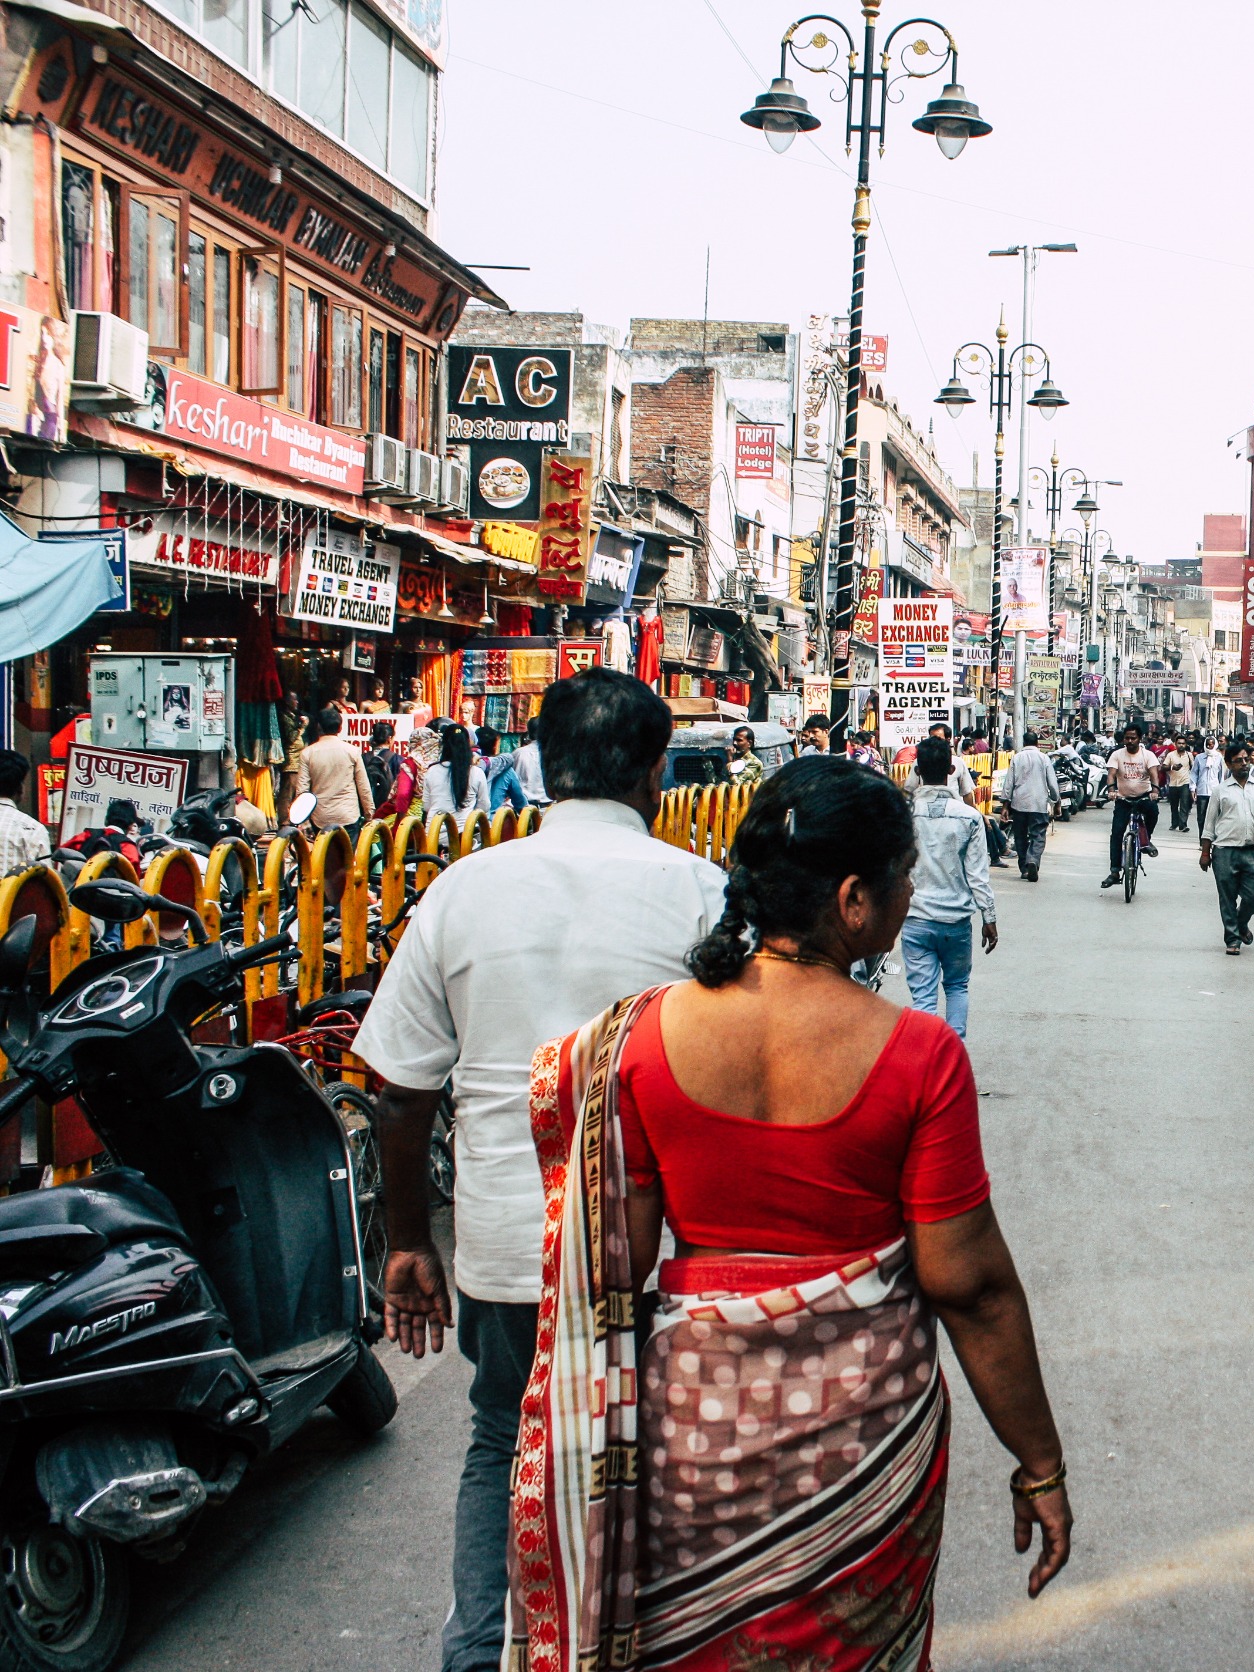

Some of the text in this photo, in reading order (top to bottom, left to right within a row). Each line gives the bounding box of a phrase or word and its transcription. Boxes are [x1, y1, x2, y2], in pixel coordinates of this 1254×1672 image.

[90, 78, 201, 175] KESHARI
[458, 355, 558, 408] A C
[447, 413, 567, 442] Restaurant
[738, 428, 773, 443] TRIPTI
[271, 418, 323, 453] Ruchikar
[324, 436, 366, 469] Byanjan
[738, 445, 772, 457] (Hotel)
[289, 452, 348, 484] Restaurant
[737, 458, 772, 469] Lodge
[311, 549, 391, 584] TRAVEL AGENT
[299, 591, 392, 627] MONEY EXCHANGE
[893, 603, 938, 622] MONEY
[880, 624, 950, 643] EXCHANGE
[95, 671, 117, 681] IPDS
[881, 682, 950, 694] TRAVEL
[887, 696, 946, 709] AGENT
[74, 752, 177, 791] पुष्पराज
[50, 1301, 156, 1356] MAESTRO
